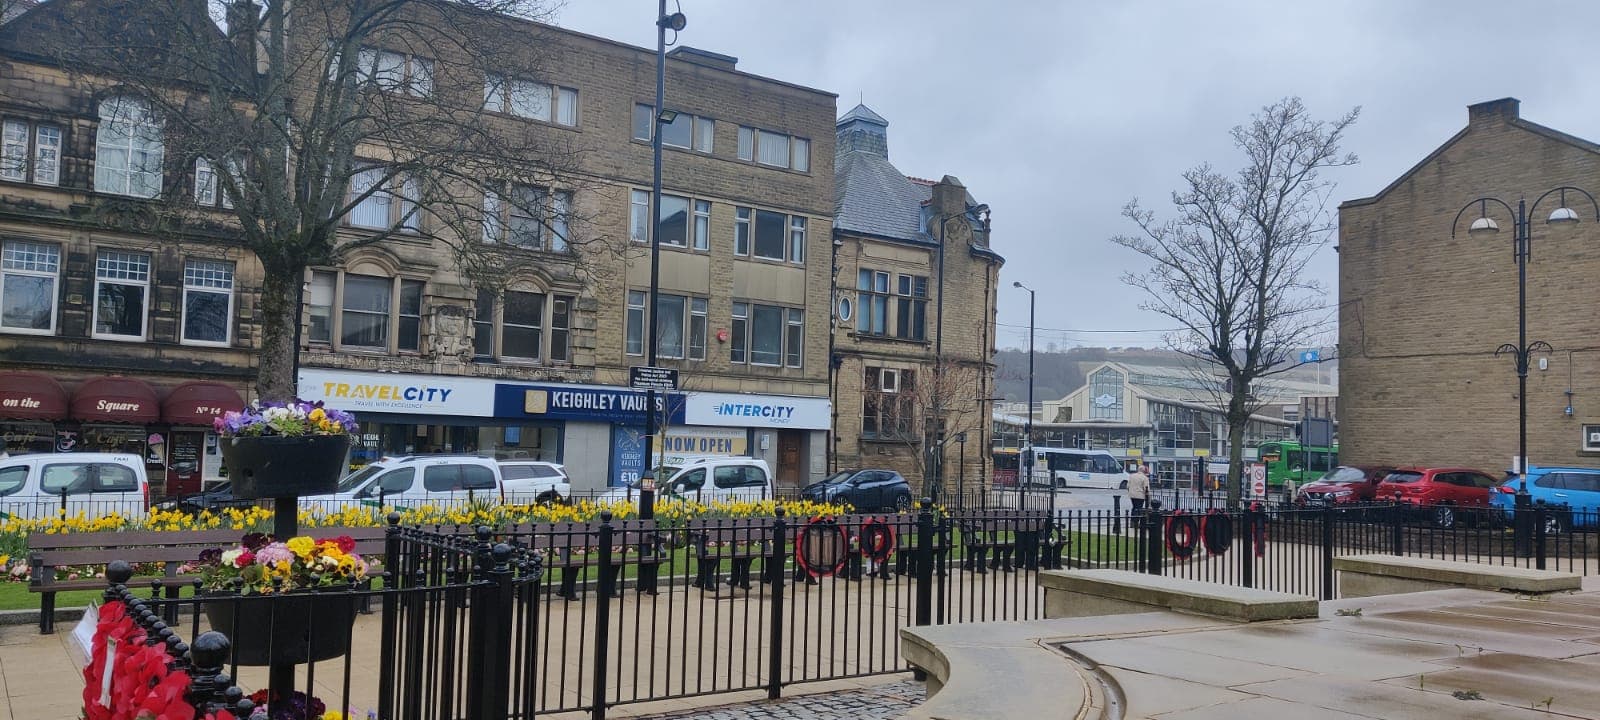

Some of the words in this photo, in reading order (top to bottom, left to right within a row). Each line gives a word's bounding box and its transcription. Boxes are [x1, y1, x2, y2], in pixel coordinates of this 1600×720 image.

[3, 398, 19, 407] on
[20, 397, 41, 408] the
[97, 399, 140, 412] Square
[552, 391, 616, 410] KEIGHLEY
[619, 395, 664, 412] VAULS
[664, 437, 696, 452] NOW
[700, 438, 732, 453] OPEN
[620, 471, 639, 482] £10
